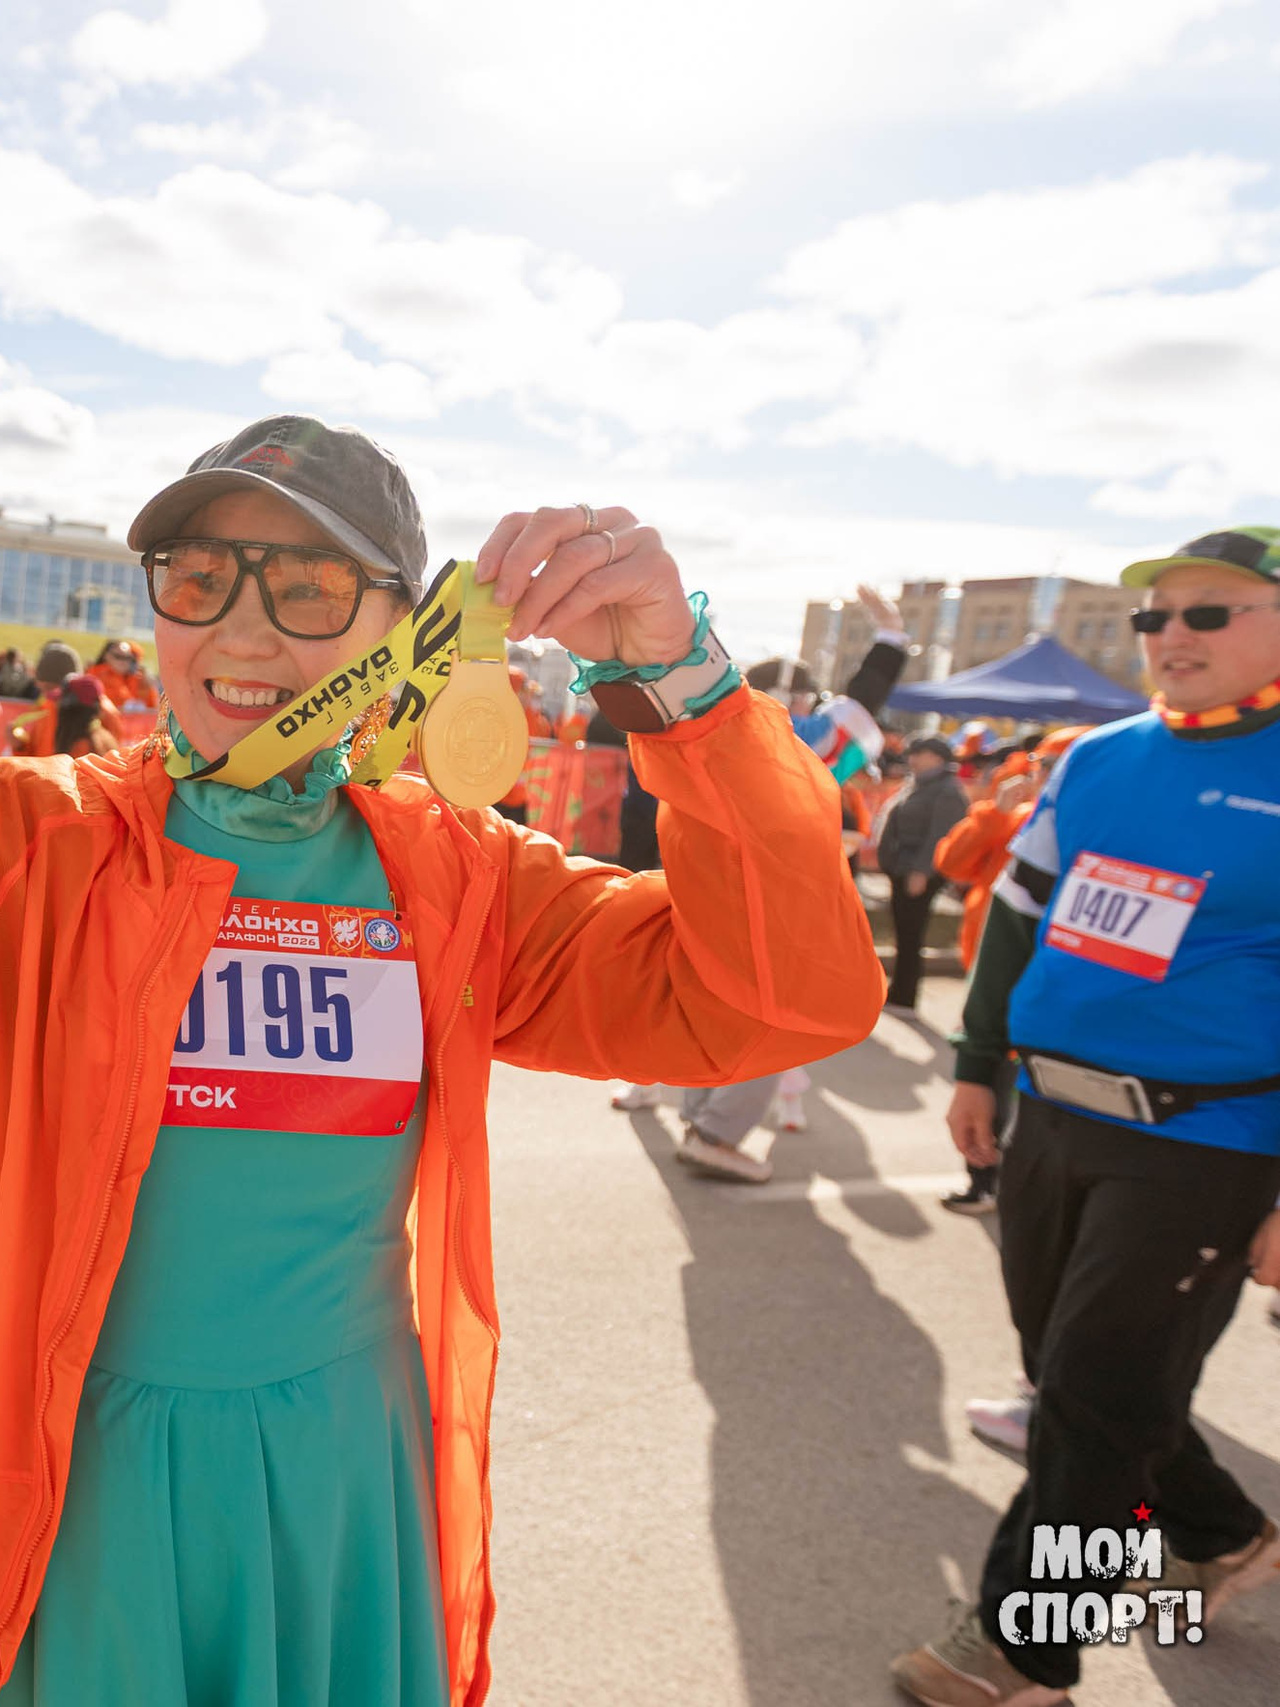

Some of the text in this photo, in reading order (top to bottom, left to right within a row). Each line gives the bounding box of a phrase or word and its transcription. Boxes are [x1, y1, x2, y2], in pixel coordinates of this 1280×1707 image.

[232, 903, 280, 915] БЕГ
[1069, 882, 1153, 938] 0407
[219, 915, 319, 934] ЛОНХО
[217, 932, 316, 947] АРАФОН 2026
[166, 1084, 237, 1109] ТСК
